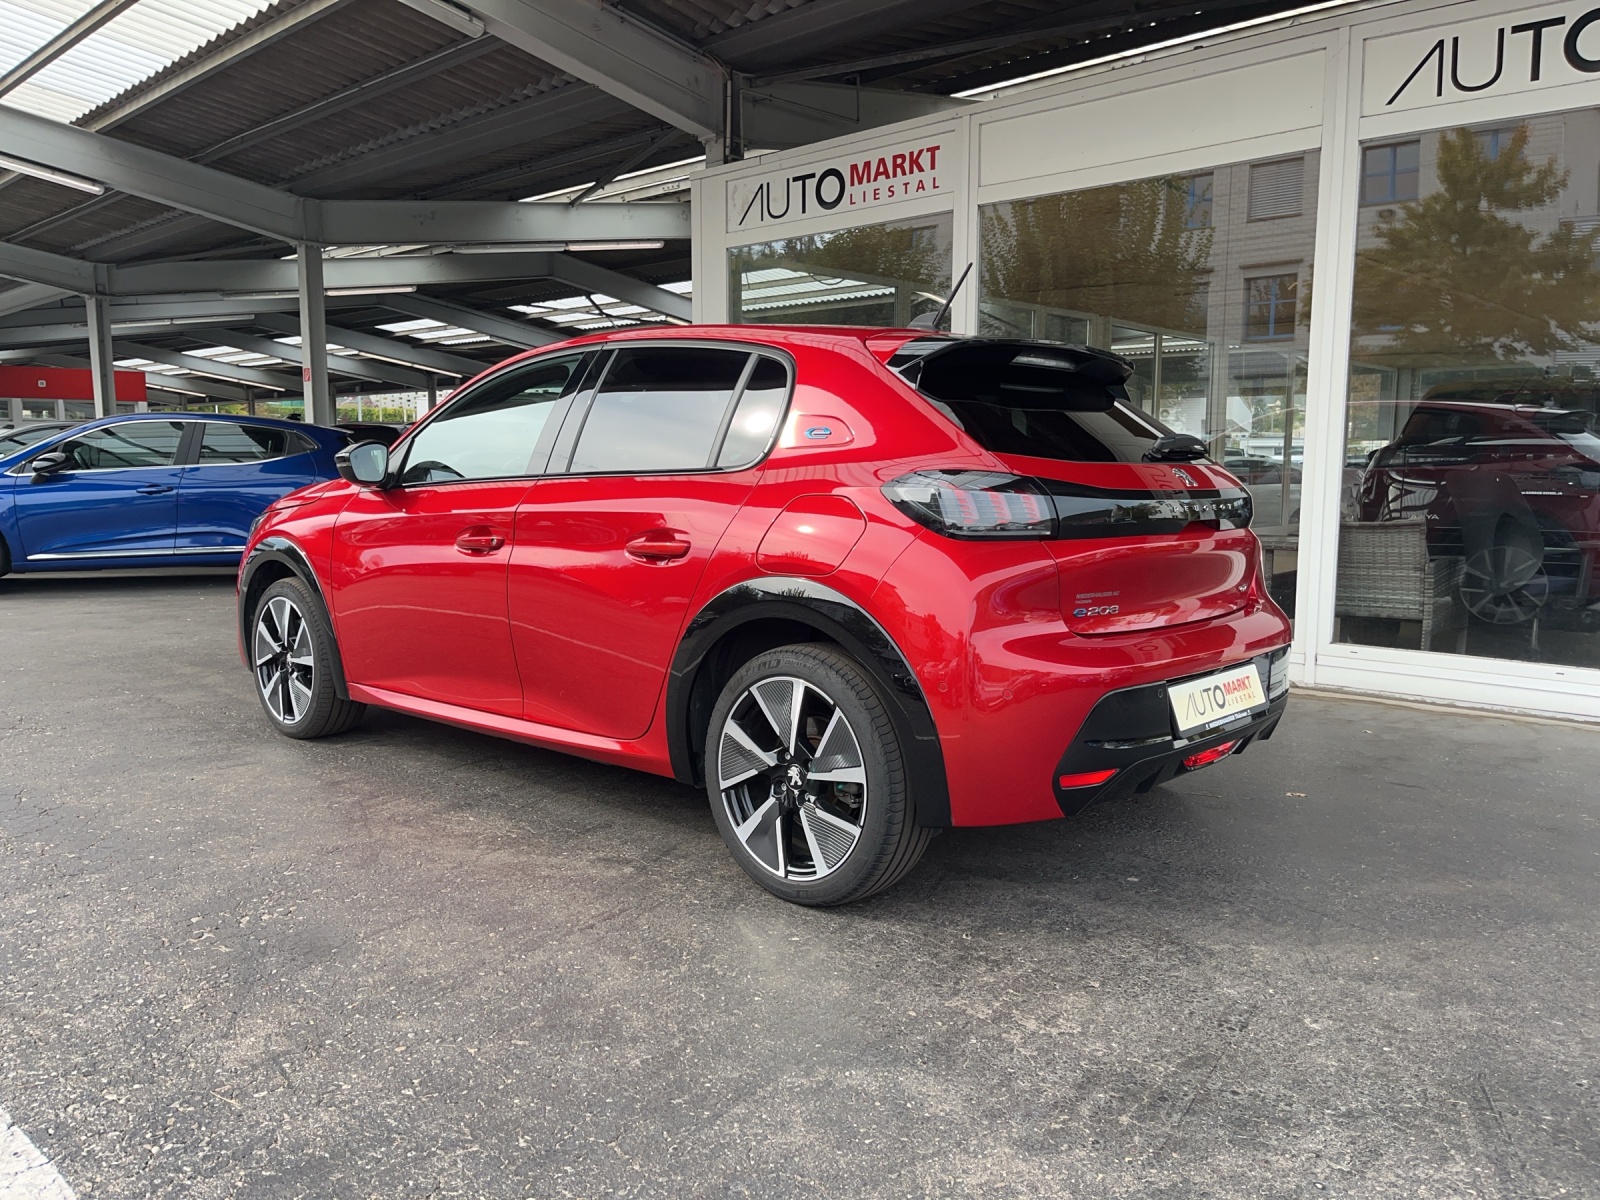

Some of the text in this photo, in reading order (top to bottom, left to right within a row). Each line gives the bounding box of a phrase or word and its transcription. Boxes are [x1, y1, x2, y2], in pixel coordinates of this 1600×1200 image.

[738, 145, 941, 226] AUTO MARKT
[849, 177, 940, 205] LIESTAL
[1173, 503, 1232, 513] PEUGEOT
[1186, 675, 1252, 720] AUTO MARKT
[1227, 691, 1256, 707] LIESTAL
